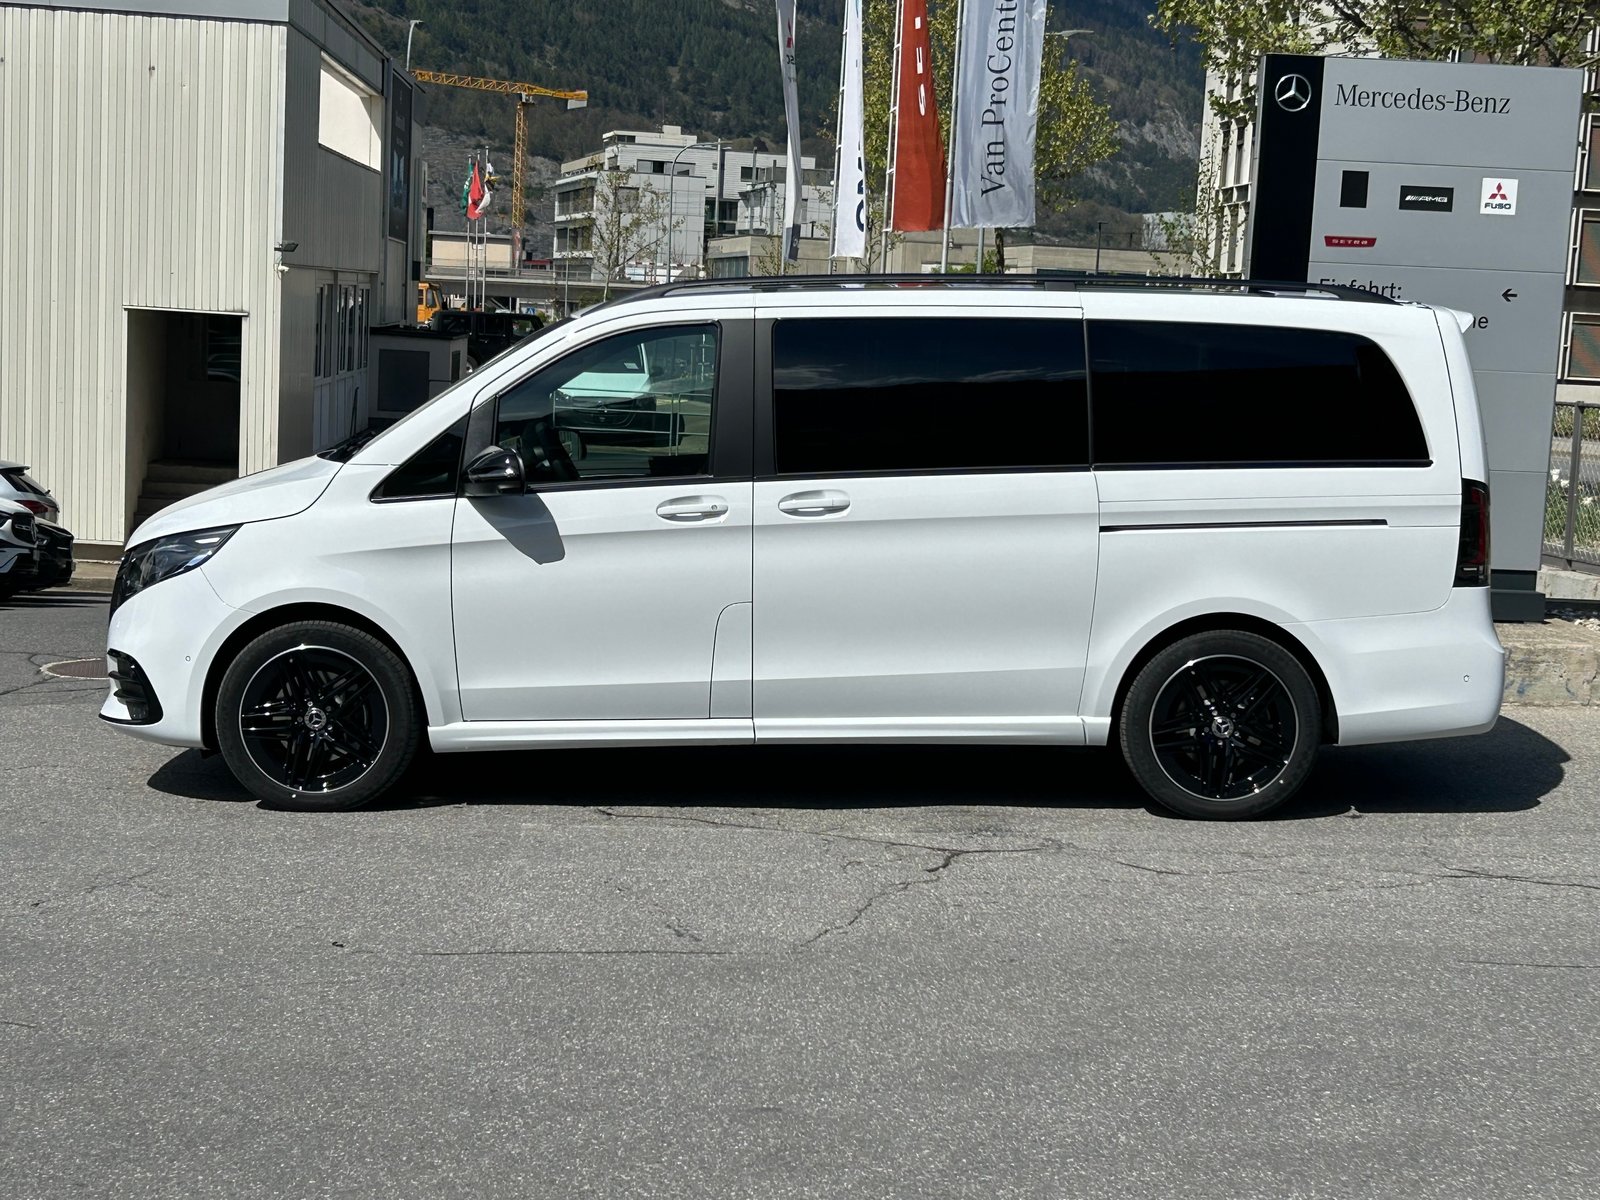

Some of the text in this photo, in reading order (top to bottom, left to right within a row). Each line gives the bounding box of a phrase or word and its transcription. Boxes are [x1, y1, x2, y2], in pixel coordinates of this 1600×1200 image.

[981, 0, 1018, 197] Van ProCent
[1334, 83, 1511, 114] Mercedes-Benz
[1416, 195, 1448, 203] AMG
[1484, 202, 1512, 210] FUSO
[1319, 278, 1402, 299] Efhrt:
